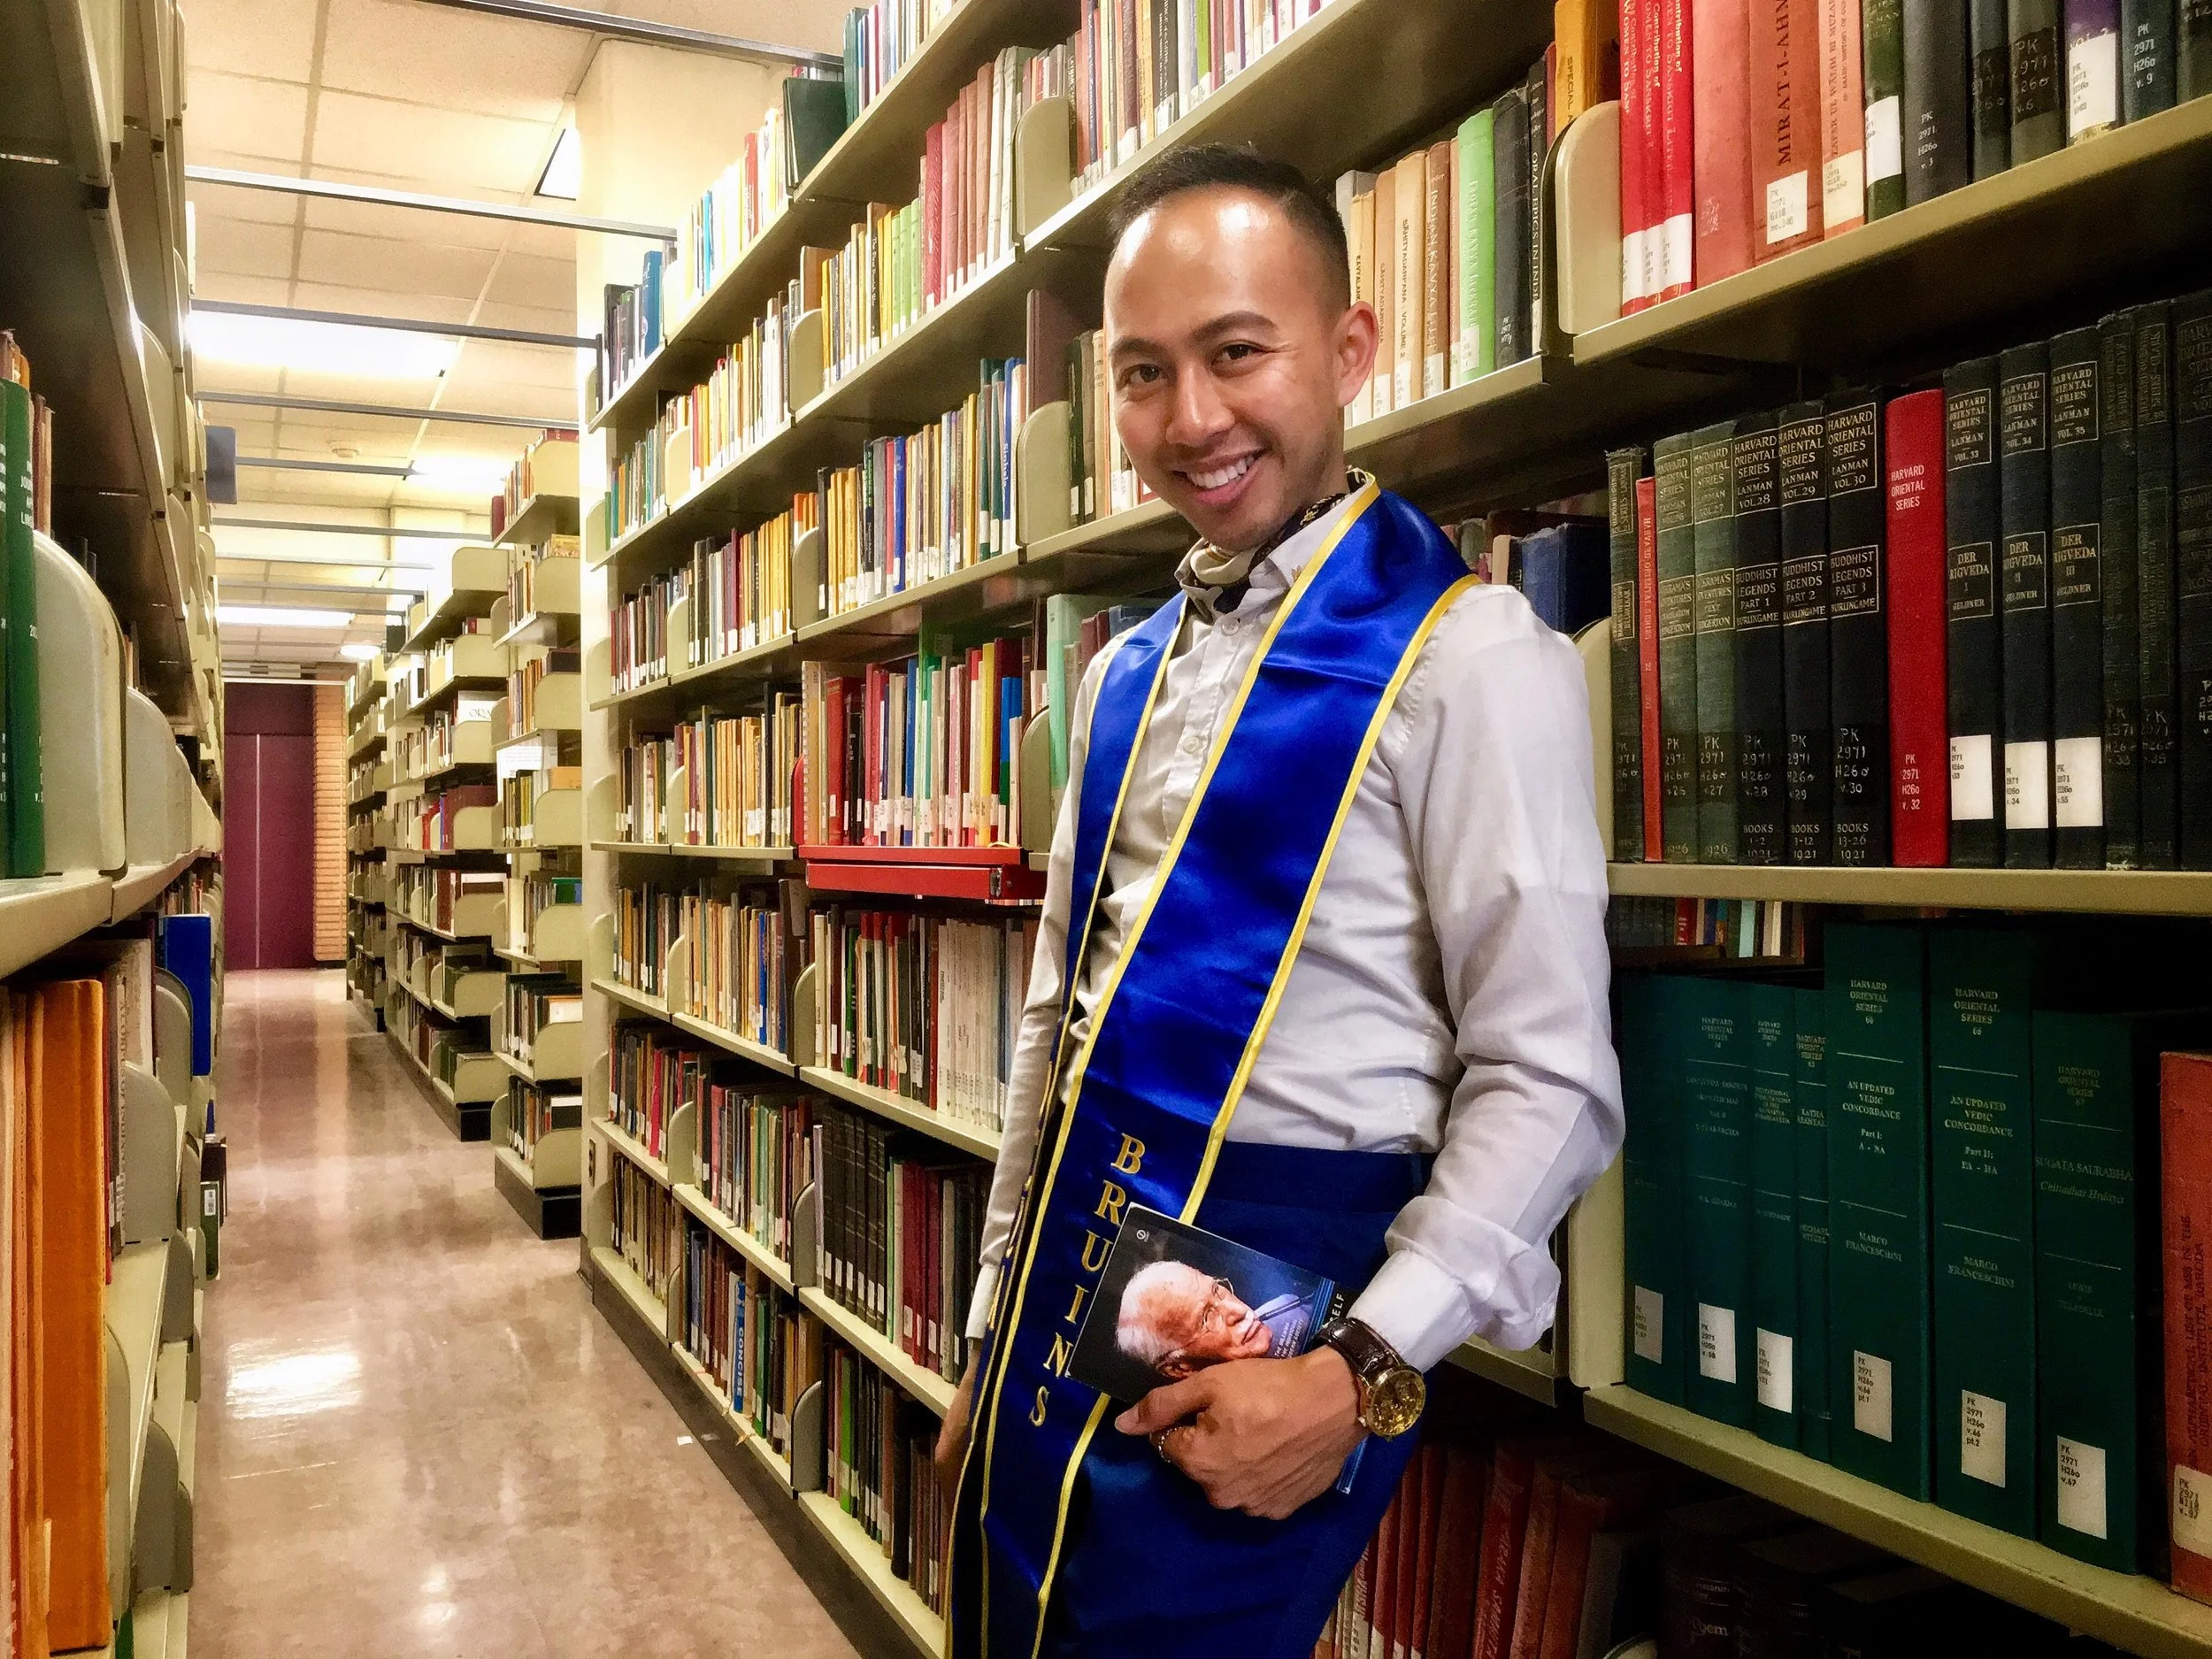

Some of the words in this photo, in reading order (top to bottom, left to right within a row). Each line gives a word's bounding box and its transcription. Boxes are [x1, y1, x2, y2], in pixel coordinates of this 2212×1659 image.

[2138, 23, 2149, 36] PK
[2134, 38, 2154, 57] 2971
[1652, 76, 1661, 87] of
[2147, 73, 2153, 85] 9
[1921, 110, 1933, 124] PK
[1918, 125, 1936, 141] 2971
[1429, 190, 1439, 246] INDIAN
[1532, 244, 1540, 261] IN
[2053, 369, 2093, 385] HARVARD
[2002, 380, 2040, 396] HARVARD
[2053, 380, 2093, 395] ORIENTAL
[1949, 396, 1986, 412] HARVARD
[2055, 391, 2086, 403] SERIES
[1949, 407, 1986, 422] ORIENTAL
[2005, 402, 2034, 415] SERIES
[2054, 407, 2090, 422] LANMAN
[1828, 411, 1873, 431] HARVARD
[1952, 418, 1981, 431] SERIES
[2004, 419, 2037, 433] LANMAN
[1778, 424, 1824, 442] HARVARD
[1828, 426, 1874, 445] ORIENTAL
[1951, 433, 1984, 447] LANMAN
[1734, 435, 1778, 455] HARVARD
[1778, 438, 1824, 457] ORIENTAL
[1832, 440, 1866, 457] SERIES
[1734, 449, 1777, 467] ORIENTAL
[1782, 452, 1816, 468] SERIES
[1738, 463, 1770, 479] SERIES
[1832, 459, 1869, 475] LANMAN
[1891, 465, 1924, 481] HARVARD
[1782, 471, 1819, 487] LANMAN
[1737, 481, 1773, 495] LANMAN
[1891, 480, 1925, 497] ORIENTAL
[1895, 496, 1920, 511] SERIES
[2061, 534, 2082, 547] DER
[2009, 541, 2029, 556] DER
[2053, 547, 2096, 564] RIGVEDA
[1831, 551, 1874, 568] BUDDHIST
[1958, 551, 1978, 565] DER
[2003, 554, 2044, 570] RIGVEDA
[1783, 560, 1824, 577] BUDDHIST
[1832, 566, 1872, 583] LEGENDS
[1949, 564, 1990, 580] RIGVEDA
[1735, 568, 1778, 585] BUDDHIST
[1783, 575, 1823, 591] LEGENDS
[1737, 582, 1776, 598] LEGENDS
[1835, 584, 1857, 595] PART
[1860, 582, 1866, 593] 3
[1786, 592, 1806, 603] PART
[1809, 590, 1816, 601] 2
[1740, 599, 1760, 611] PART
[1832, 597, 1876, 612] BURLINGAME
[1791, 734, 1807, 748] PK
[1840, 727, 1860, 742] PK
[1667, 738, 1679, 749] PK
[1704, 737, 1719, 749] PK
[1701, 751, 1724, 764] 2971
[1787, 753, 1810, 765] 2971
[1837, 746, 1866, 759] 2971
[1905, 754, 1916, 764] PK
[1902, 769, 1919, 780] 2971
[1910, 800, 1920, 810] 32
[1743, 824, 1774, 833] BOOKS
[1791, 824, 1820, 833] BOOKS
[1837, 823, 1869, 833] BOOKS
[1839, 837, 1867, 846] 13-26
[1793, 850, 1816, 861] 1921
[1840, 850, 1865, 861] 1921
[1850, 980, 1887, 991] HARVARD
[1850, 992, 1888, 1002] ORIENTAL
[1955, 987, 1999, 1000] HARVARD
[1855, 1003, 1883, 1014] SERIES
[1954, 1001, 2000, 1013] ORIENTAL
[1961, 1013, 1993, 1024] SERIES
[1847, 1080, 1858, 1089] AN
[1860, 1081, 1895, 1095] UPDATED
[1859, 1094, 1883, 1105] VEDIC
[1950, 1096, 1963, 1105] AN
[1965, 1097, 2006, 1111] UPDATED
[1842, 1103, 1901, 1120] CONCORDANCE
[1964, 1110, 1993, 1122] VEDIC
[1861, 1128, 1875, 1139] Part
[1945, 1119, 2014, 1137] CONCORDANCE
[1964, 1146, 1981, 1156] Part
[1859, 1232, 1887, 1246] MARCO
[1846, 1240, 1902, 1262] FRANCESCHINI
[1963, 1256, 1998, 1271] MARCO
[1028, 1131, 1146, 1428] BRUINS
[1947, 1264, 2015, 1288] FRANCESCHINI
[1701, 1333, 1715, 1341] 2971
[1858, 1356, 1866, 1365] PK
[1858, 1366, 1872, 1378] 2971
[1967, 1397, 1976, 1407] PK
[1966, 1407, 1983, 1418] 2971
[1966, 1438, 1980, 1448] pt.2
[2061, 1444, 2070, 1455] PK
[2061, 1455, 2078, 1467] 2971
[2061, 1477, 2077, 1487] v.67
[2179, 1478, 2188, 1489] PK
[2179, 1487, 2199, 1501] 2971
